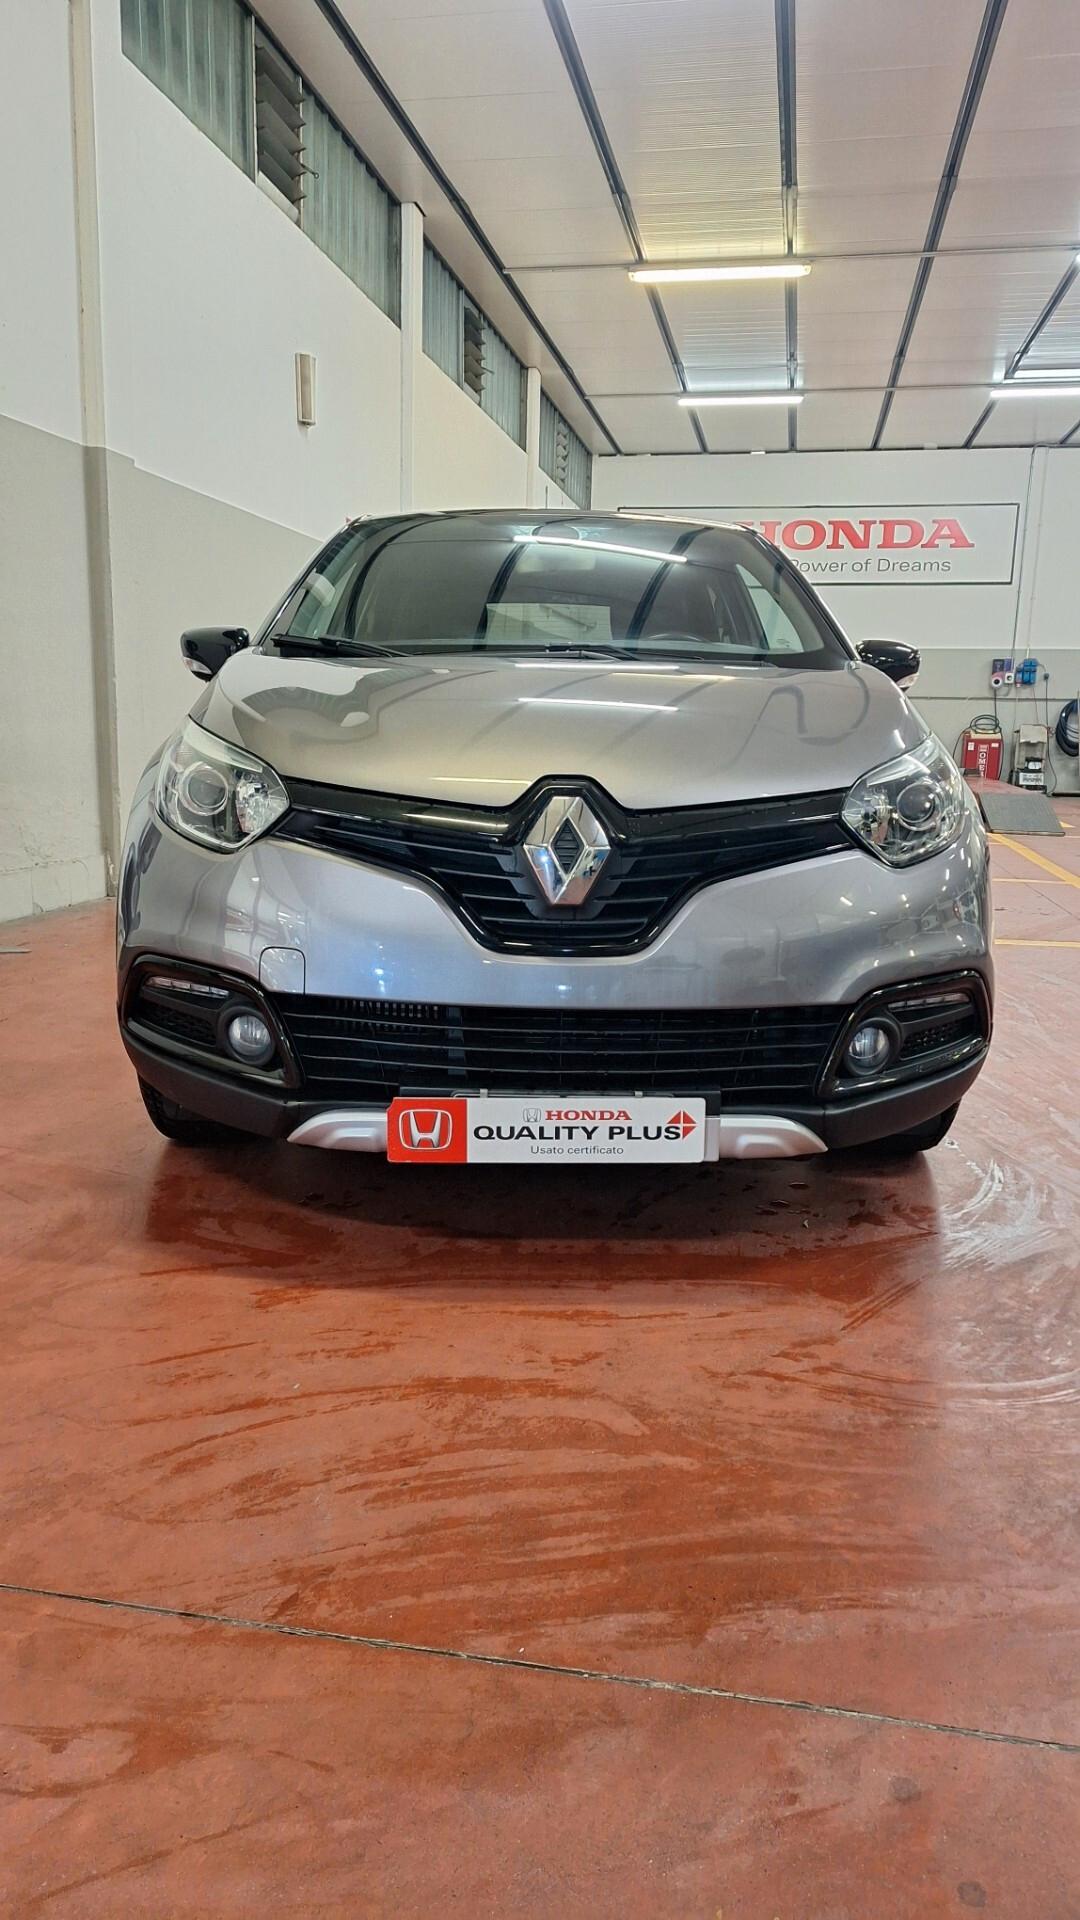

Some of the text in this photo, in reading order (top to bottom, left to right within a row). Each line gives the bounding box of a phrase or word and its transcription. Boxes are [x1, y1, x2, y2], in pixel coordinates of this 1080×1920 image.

[851, 558, 872, 572] of
[877, 558, 952, 572] Dreams
[545, 1110, 632, 1121] HONDA
[473, 1126, 681, 1140] QUALITY PLUS
[530, 1145, 624, 1155] Usato certificato
